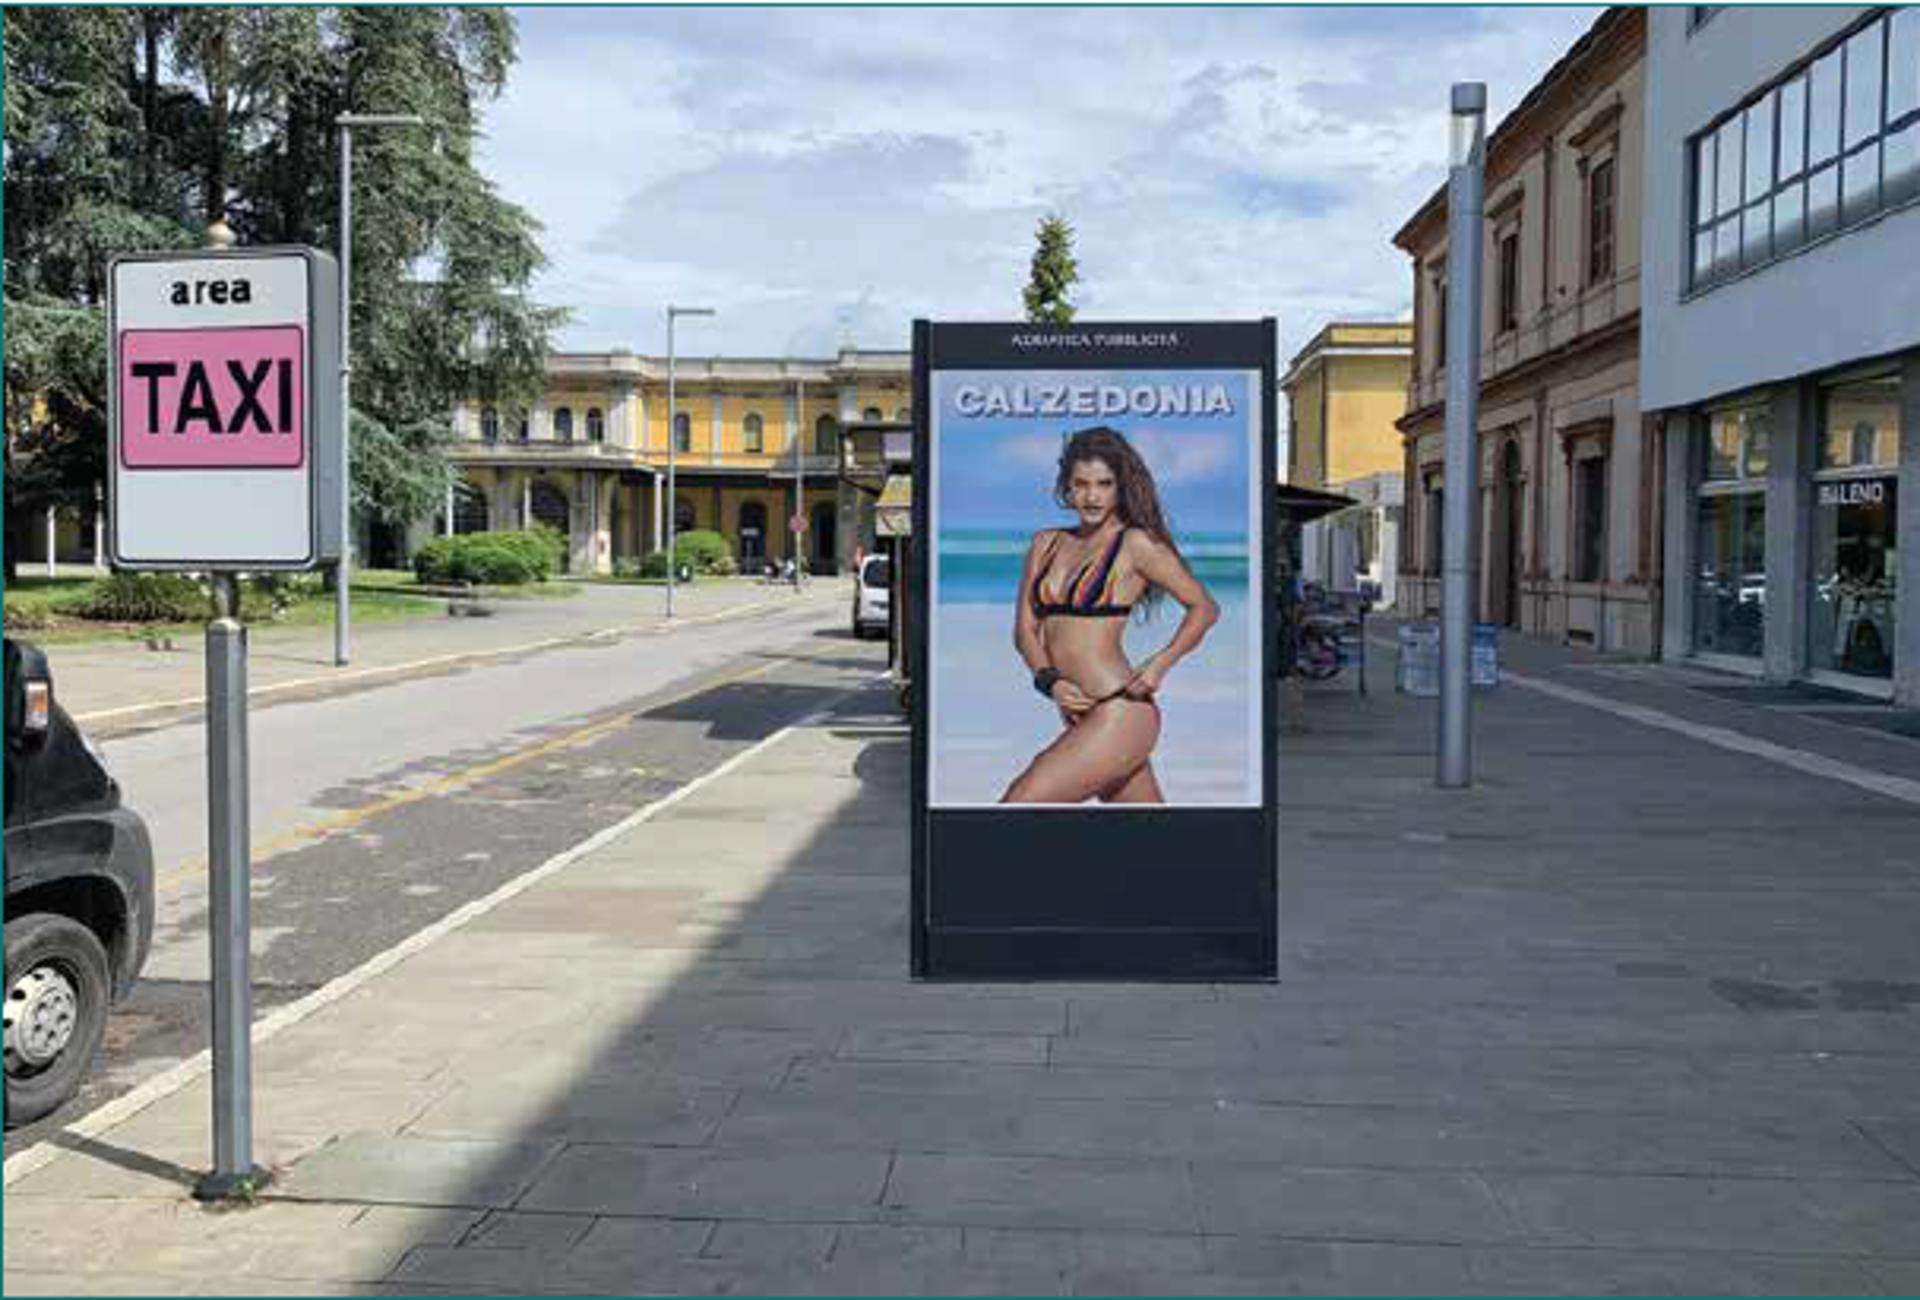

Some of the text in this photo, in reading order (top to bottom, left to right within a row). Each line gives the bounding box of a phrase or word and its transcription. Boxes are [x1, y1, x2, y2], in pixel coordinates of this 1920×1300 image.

[171, 278, 251, 304] area
[131, 359, 292, 433] TAXI
[954, 385, 1233, 418] CALZEDONIA
